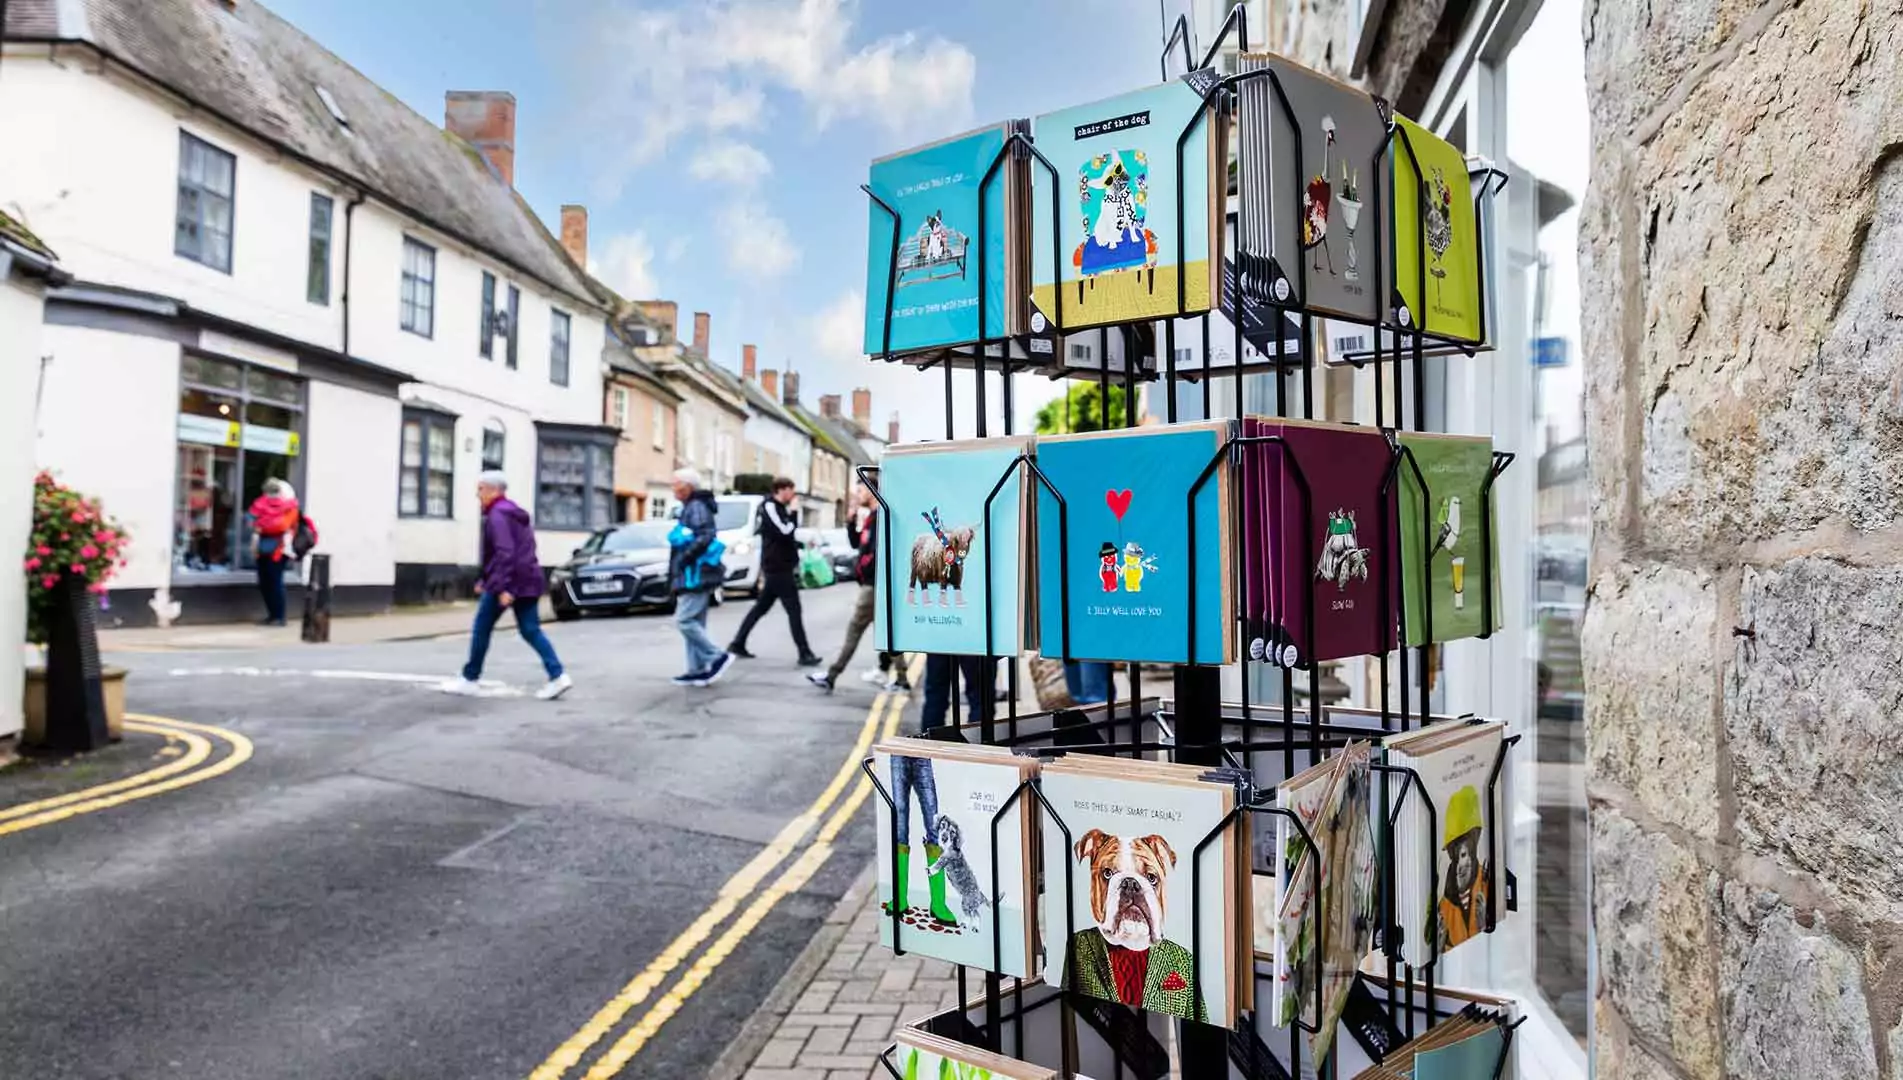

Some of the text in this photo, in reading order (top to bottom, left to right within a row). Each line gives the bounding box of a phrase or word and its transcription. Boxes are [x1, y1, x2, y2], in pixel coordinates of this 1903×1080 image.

[1077, 115, 1147, 136] chair of the dog
[1111, 606, 1129, 615] WELL
[1130, 606, 1147, 616] LOVE
[1148, 606, 1163, 616] YOU
[1073, 799, 1090, 810] DOES
[1091, 801, 1109, 813] THIS
[1110, 804, 1123, 814] SAY
